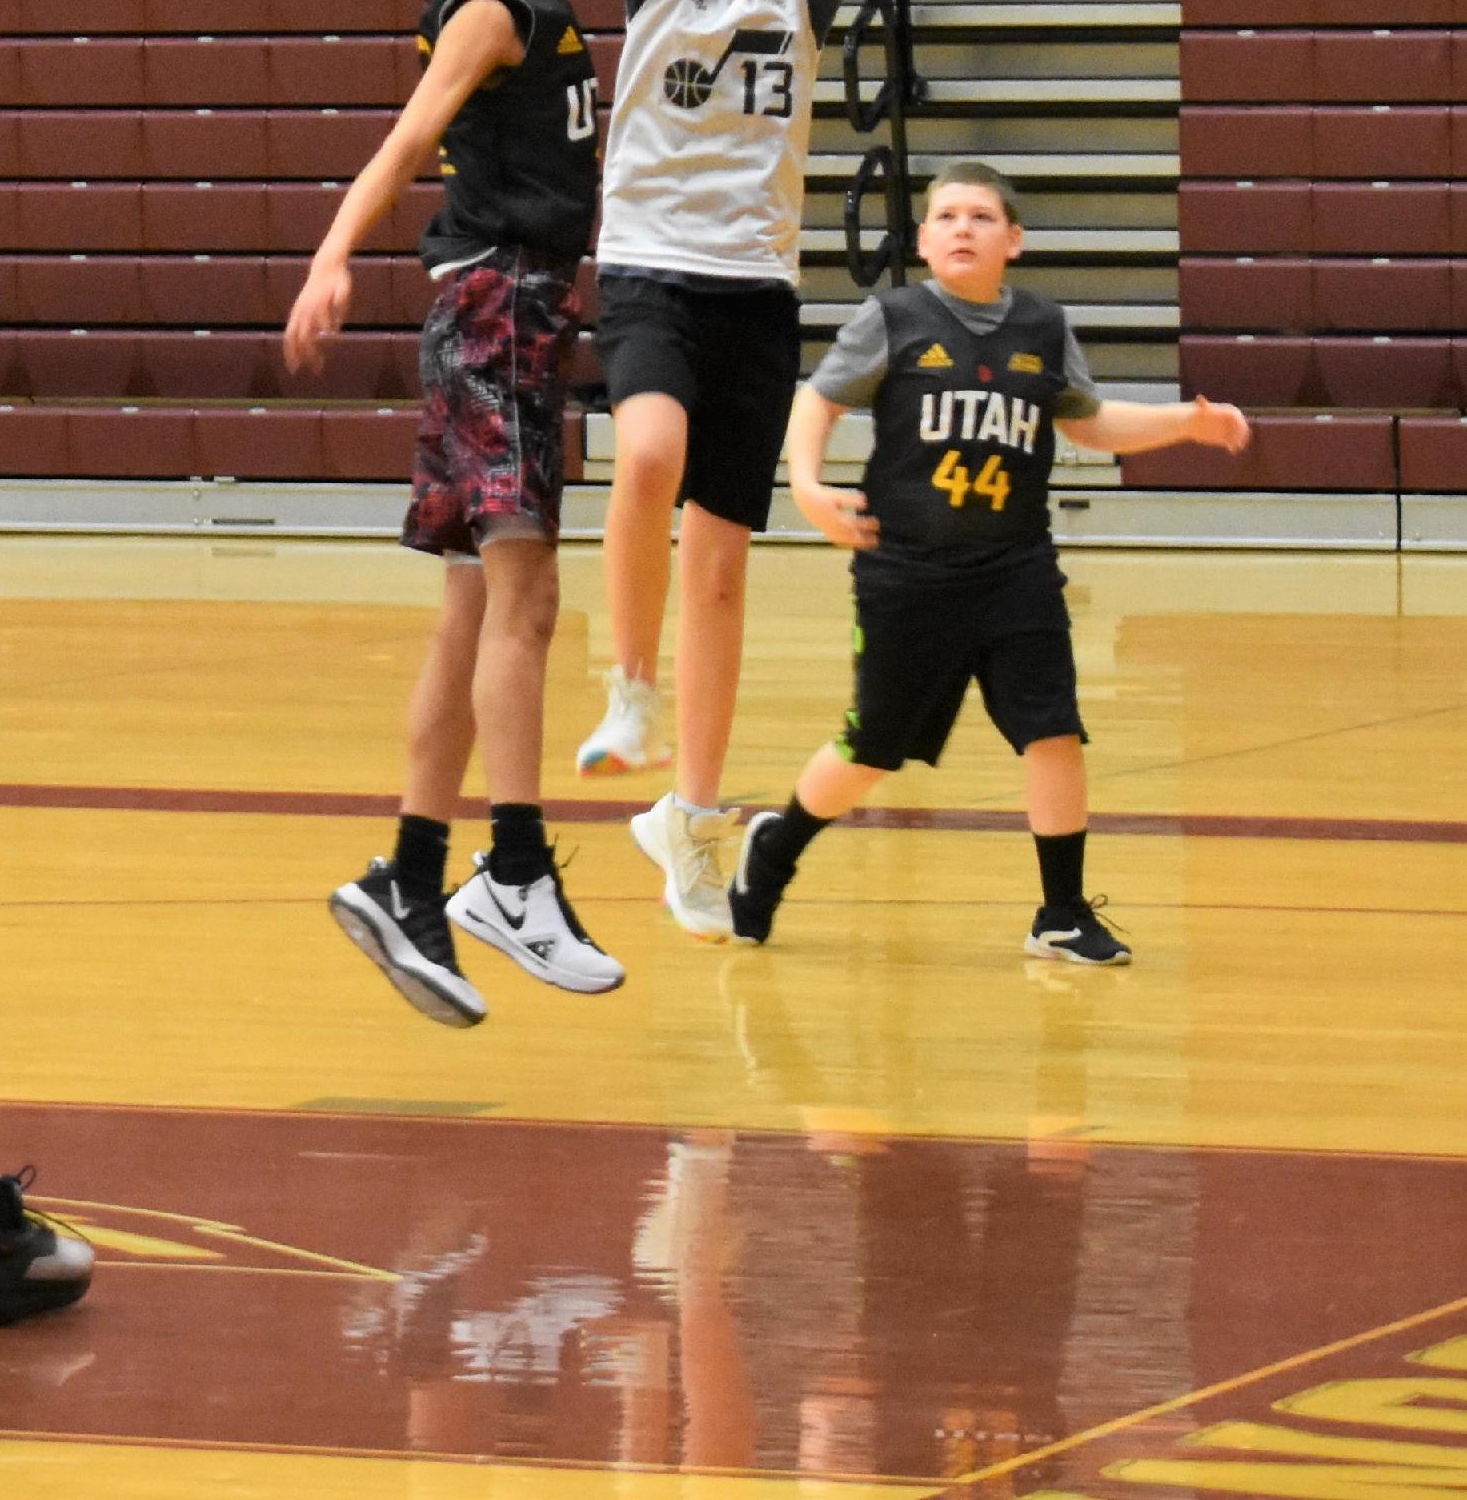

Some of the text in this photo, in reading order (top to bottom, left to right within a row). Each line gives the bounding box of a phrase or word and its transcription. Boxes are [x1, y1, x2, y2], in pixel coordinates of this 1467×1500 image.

[742, 61, 793, 118] 13
[920, 390, 1041, 454] UTAH
[933, 450, 1012, 512] 44
